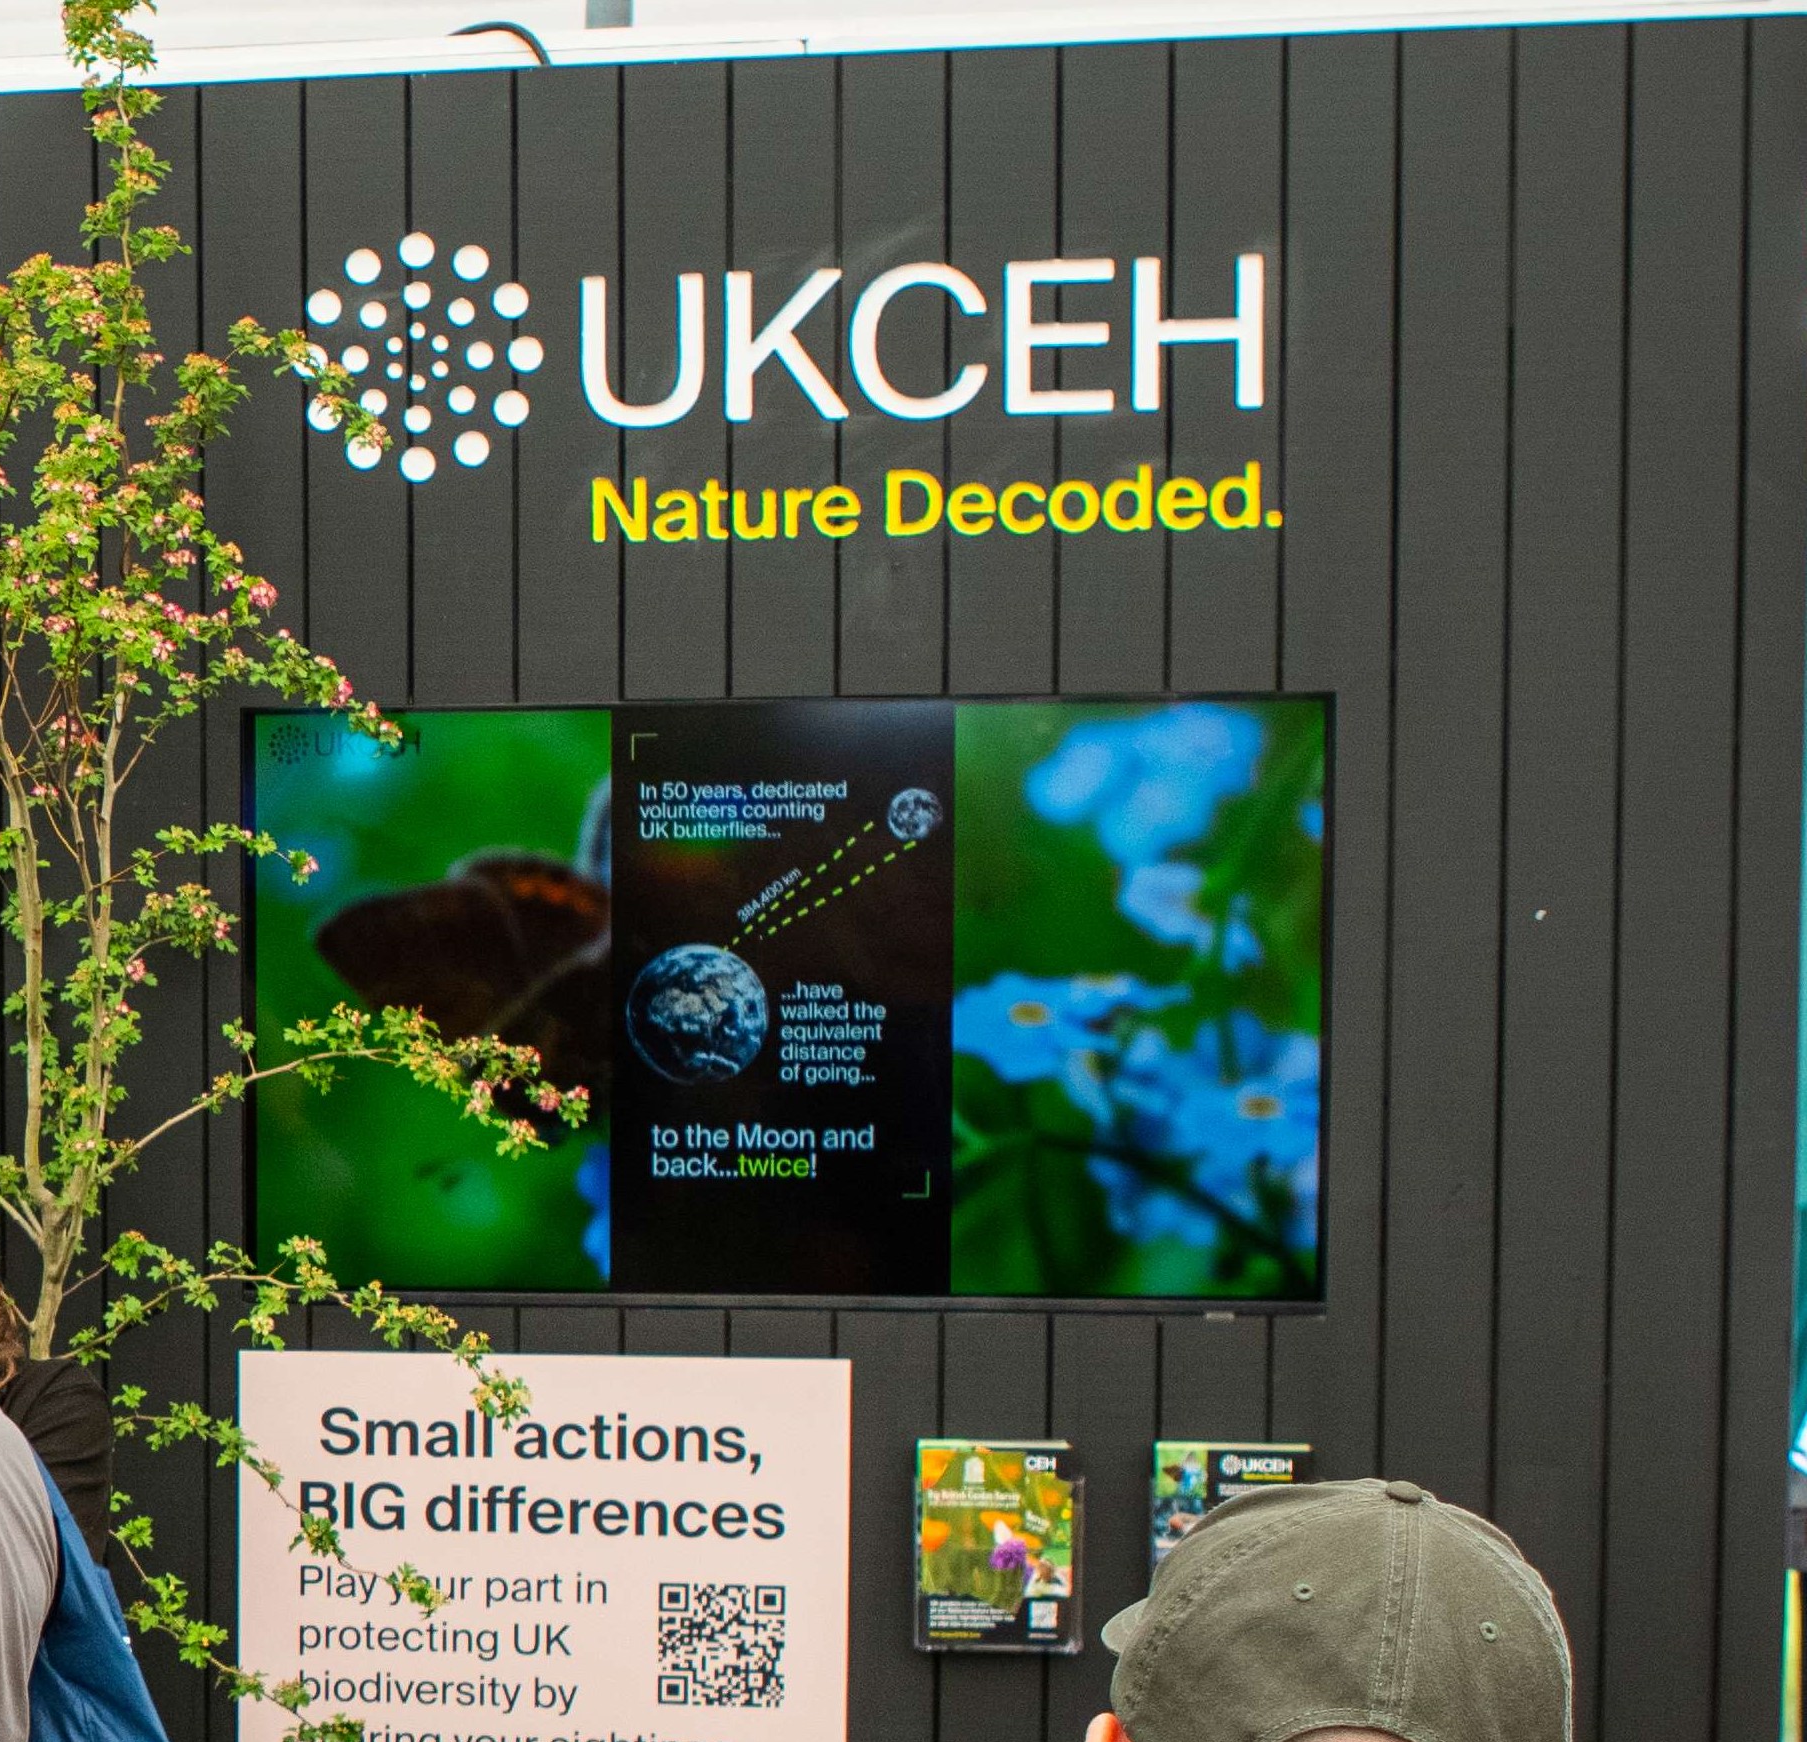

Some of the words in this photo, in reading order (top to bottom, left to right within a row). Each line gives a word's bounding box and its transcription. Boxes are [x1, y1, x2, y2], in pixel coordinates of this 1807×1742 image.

[579, 253, 1265, 428] UKCEH
[591, 476, 861, 543] Nature
[883, 460, 1284, 537] Decoded.
[639, 782, 659, 800] In
[661, 782, 688, 801] 50
[691, 782, 748, 803] years,
[750, 779, 847, 800] dedicated
[639, 801, 737, 820] volunteers
[742, 800, 826, 822] counting
[639, 822, 669, 840] UK
[672, 820, 782, 841] butterflies...
[781, 980, 844, 1000] ...have
[780, 1001, 851, 1022] walked
[853, 1001, 887, 1022] the
[780, 1022, 883, 1045] equivalent
[780, 1042, 867, 1062] distance
[780, 1062, 801, 1083] of
[804, 1064, 876, 1088] going...
[651, 1125, 679, 1149] to
[686, 1124, 731, 1149] the
[736, 1124, 816, 1150] Moon
[822, 1124, 875, 1149] and
[320, 1405, 494, 1458] Small
[513, 1411, 763, 1475] actions,
[299, 1480, 407, 1533] BIG
[425, 1482, 786, 1540] differences
[299, 1564, 378, 1605] Play
[485, 1570, 568, 1608] part
[576, 1571, 609, 1604] in
[298, 1618, 499, 1662] protecting
[512, 1623, 572, 1657] UK
[299, 1669, 522, 1714] biodiversity
[533, 1676, 578, 1717] by
